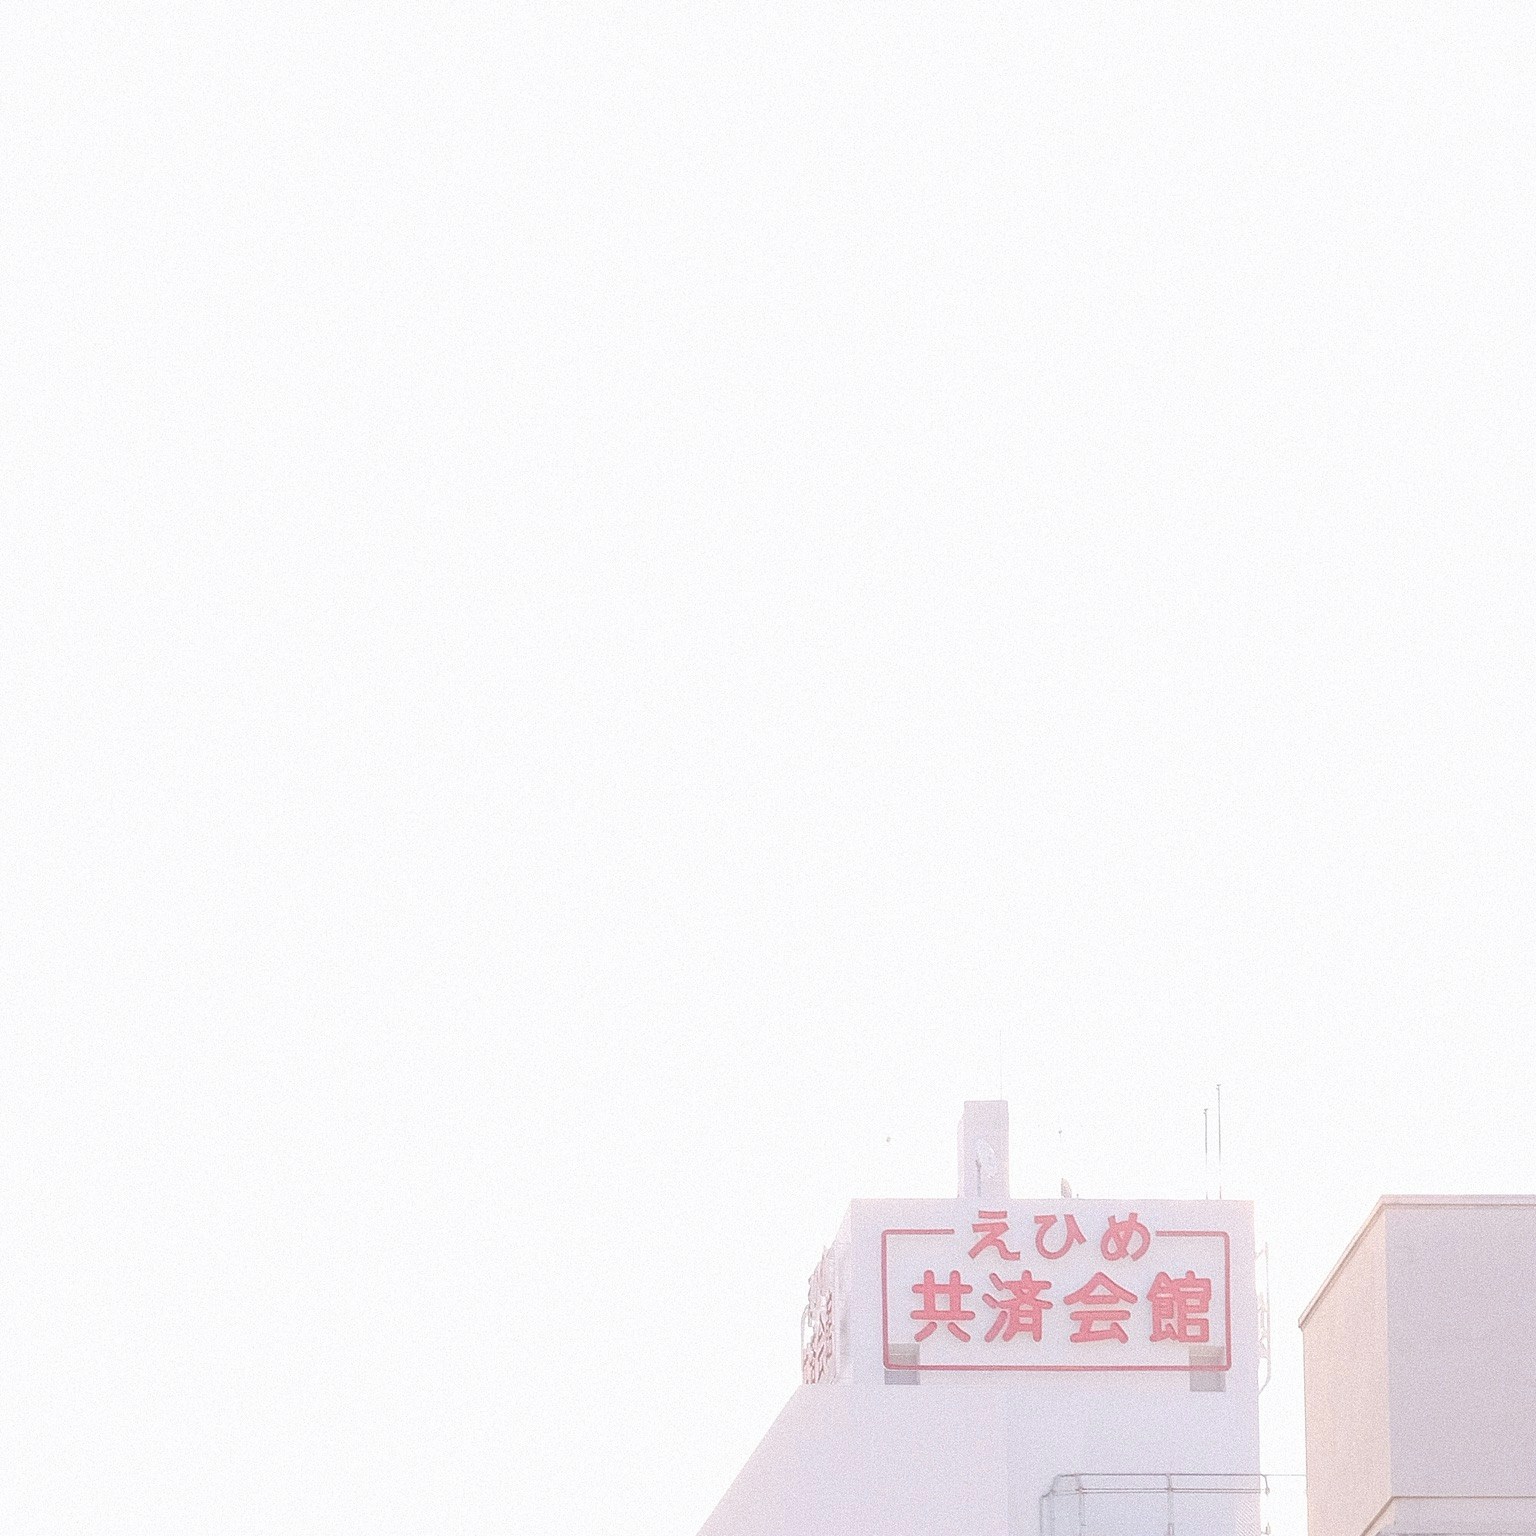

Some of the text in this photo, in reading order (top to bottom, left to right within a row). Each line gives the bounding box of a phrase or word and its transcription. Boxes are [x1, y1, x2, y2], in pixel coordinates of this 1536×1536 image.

[968, 1210, 1151, 1262] えひめ
[909, 1268, 1213, 1343] 共済会館
